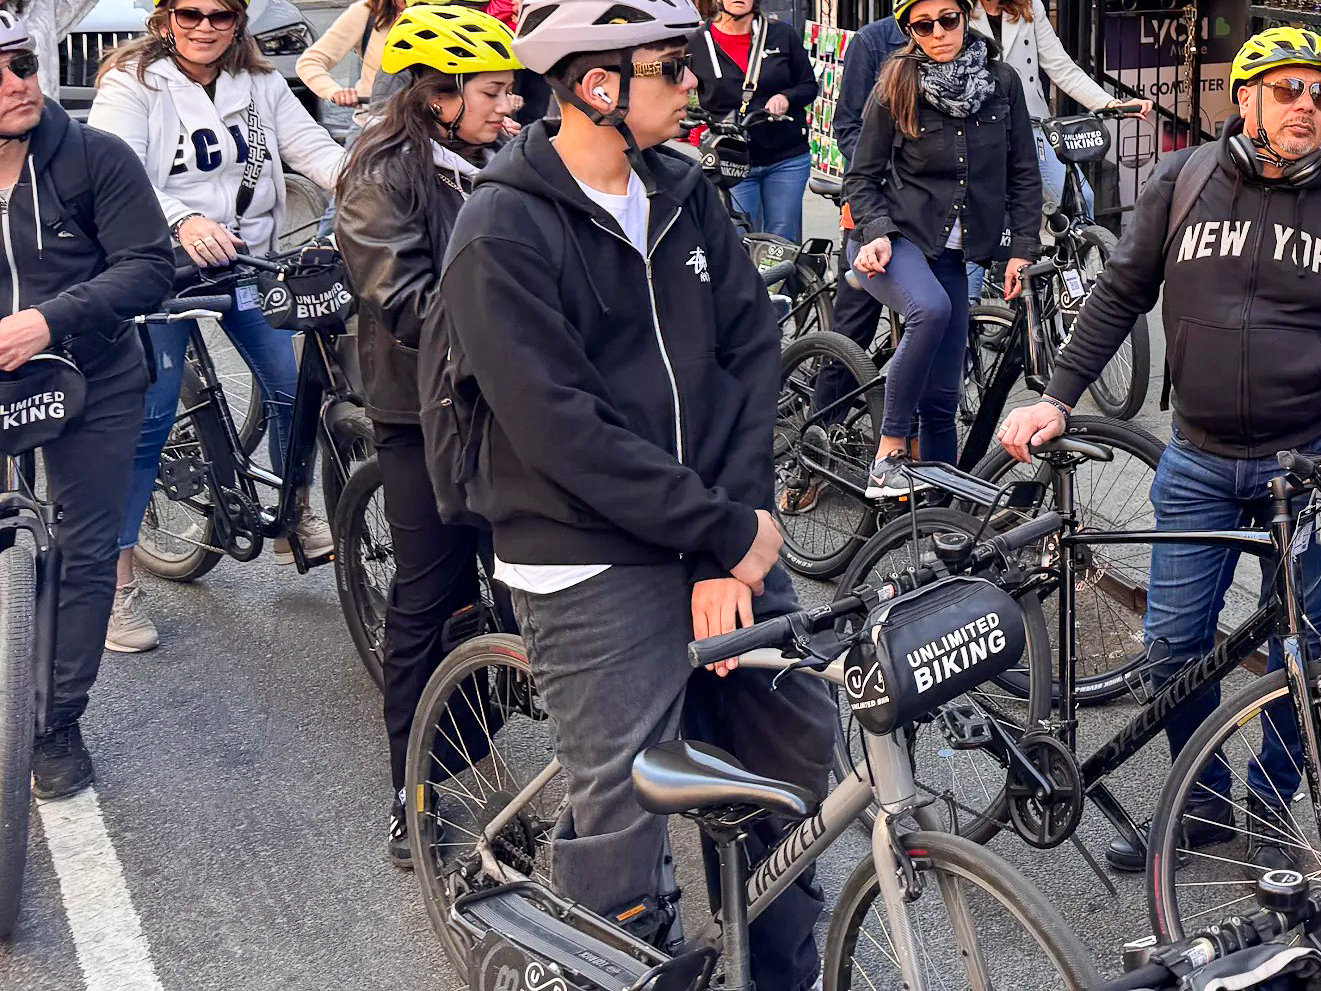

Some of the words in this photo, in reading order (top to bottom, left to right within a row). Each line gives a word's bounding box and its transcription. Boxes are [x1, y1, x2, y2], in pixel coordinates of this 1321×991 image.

[1177, 221, 1251, 263] NEW
[786, 552, 813, 568] KENDA
[906, 612, 1000, 668] UNLIMITED
[913, 629, 1007, 694] BIKING
[1104, 641, 1230, 762] SPECIALIZED
